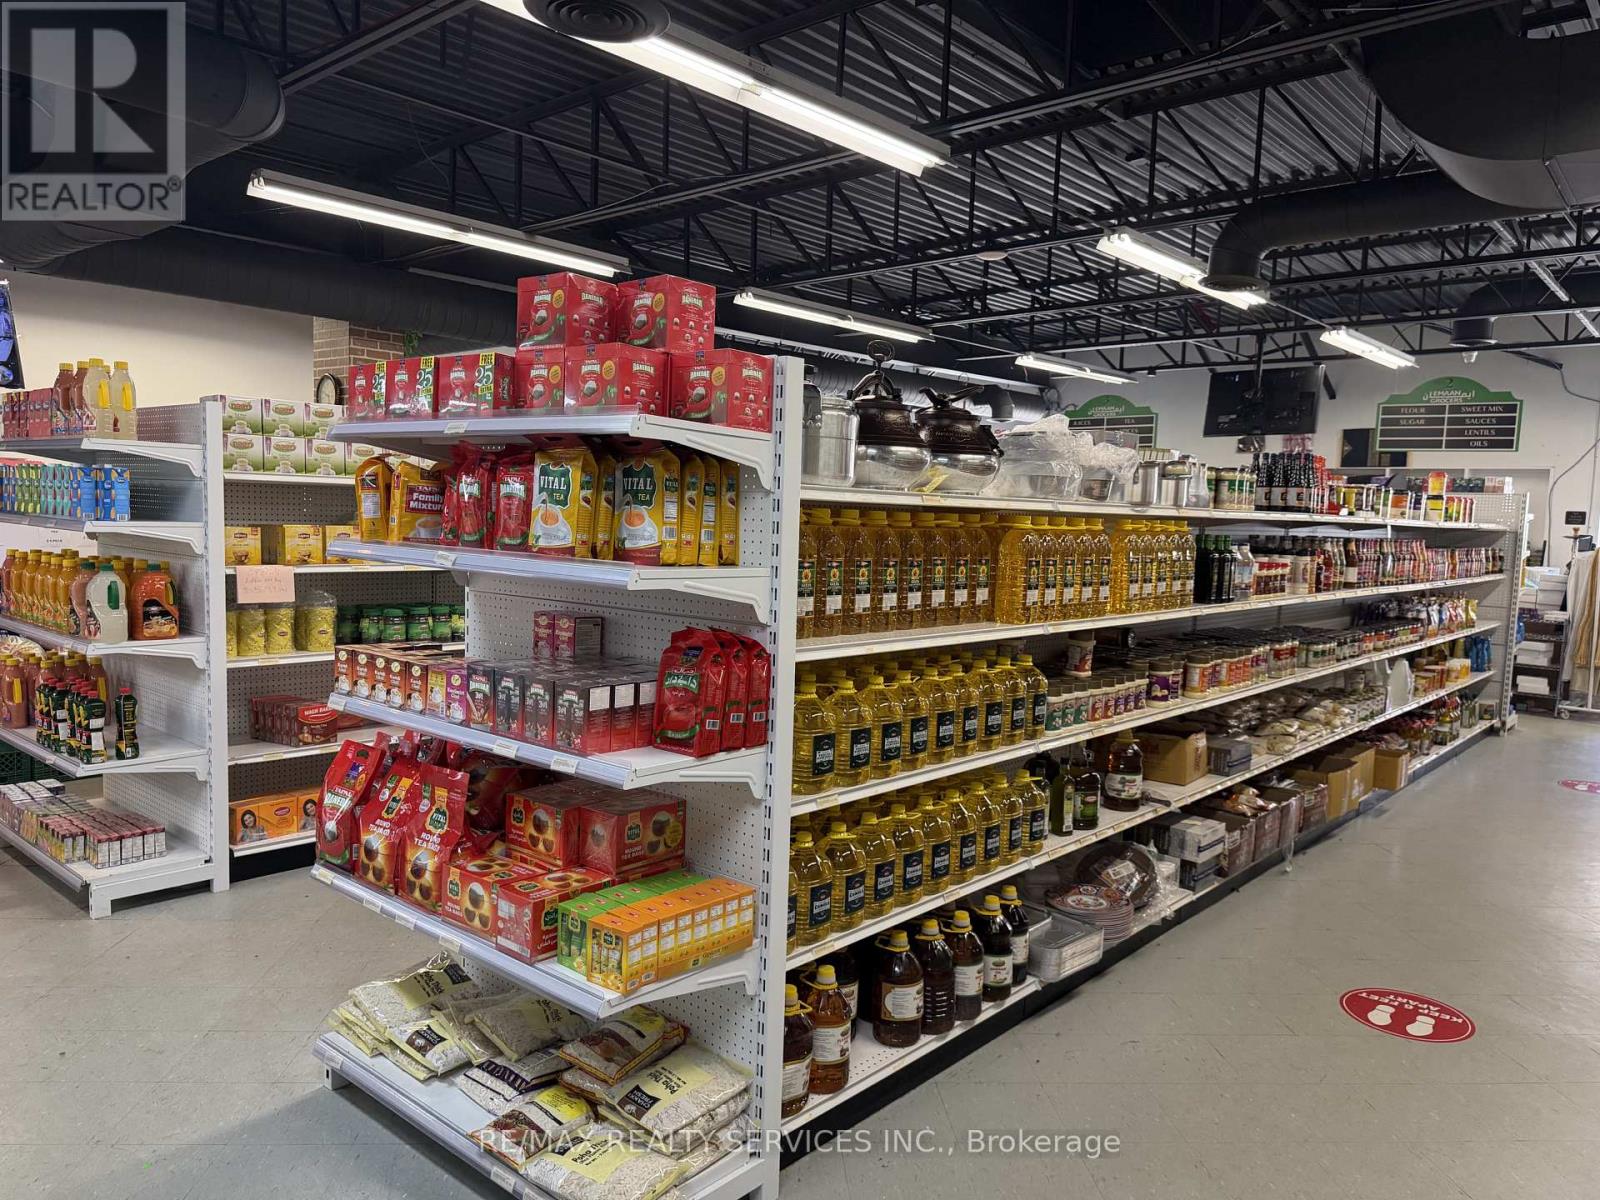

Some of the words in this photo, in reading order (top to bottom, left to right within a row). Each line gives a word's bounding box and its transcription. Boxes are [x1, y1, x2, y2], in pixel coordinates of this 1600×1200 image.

[422, 357, 433, 368] FREE
[481, 354, 494, 365] FREE
[417, 369, 432, 391] 25
[474, 365, 493, 388] 25
[1464, 429, 1496, 437] LENTILS
[540, 475, 567, 490] VITAL
[623, 477, 653, 490] VITAL
[413, 493, 444, 503] Family
[1358, 992, 1400, 1006] FEET
[1386, 994, 1441, 1012] APART
[1418, 1008, 1463, 1024] KEEP
[571, 1150, 592, 1163] Poha
